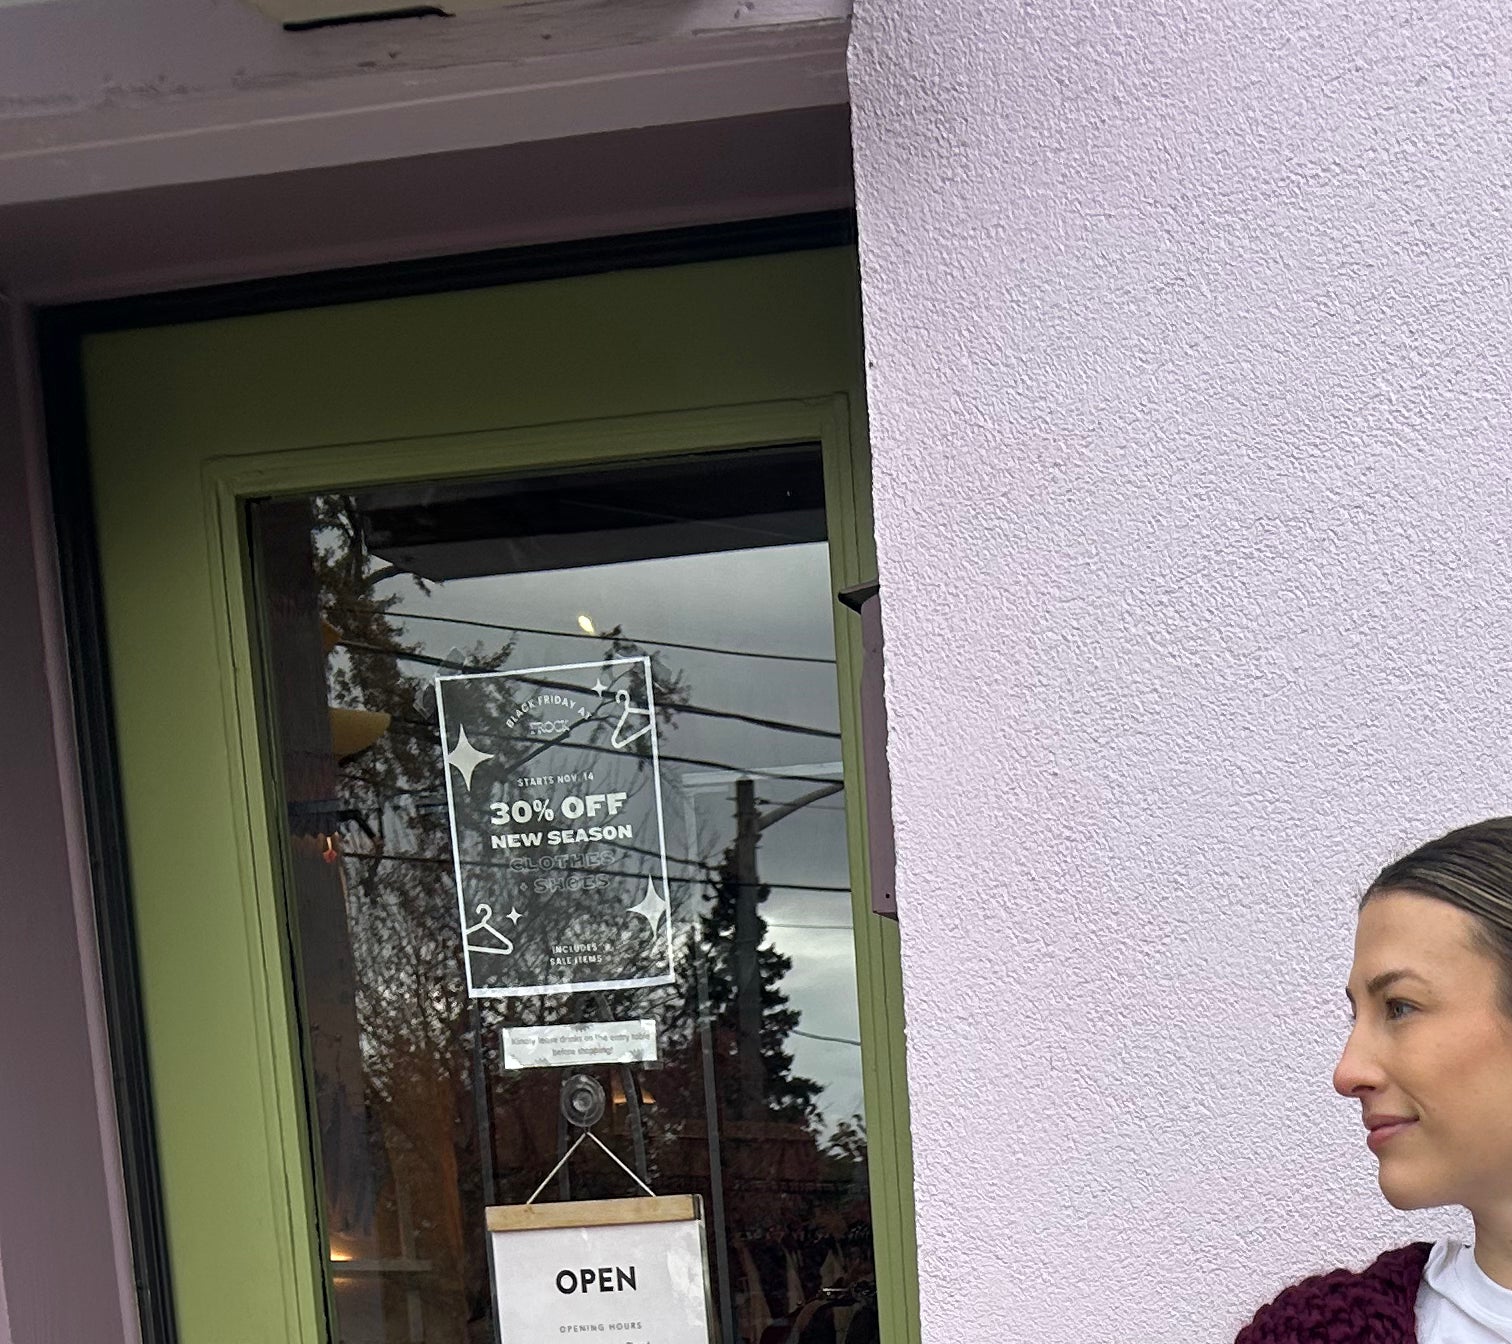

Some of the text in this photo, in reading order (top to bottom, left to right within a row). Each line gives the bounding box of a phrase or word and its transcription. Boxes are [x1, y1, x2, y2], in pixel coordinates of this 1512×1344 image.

[506, 695, 592, 728] BLACK FRIDAY AT
[517, 776, 554, 787] STARTS
[583, 771, 594, 780] 14
[489, 792, 627, 825] 30% OFF
[491, 824, 633, 849] NEW SEASON
[510, 850, 615, 872] CLOTHES
[534, 873, 611, 893] SHOES
[552, 942, 598, 954] INCLUDES
[550, 954, 602, 966] SALE ITEMS
[555, 1266, 637, 1294] OPEN
[559, 1321, 642, 1334] OPENING HOURS
